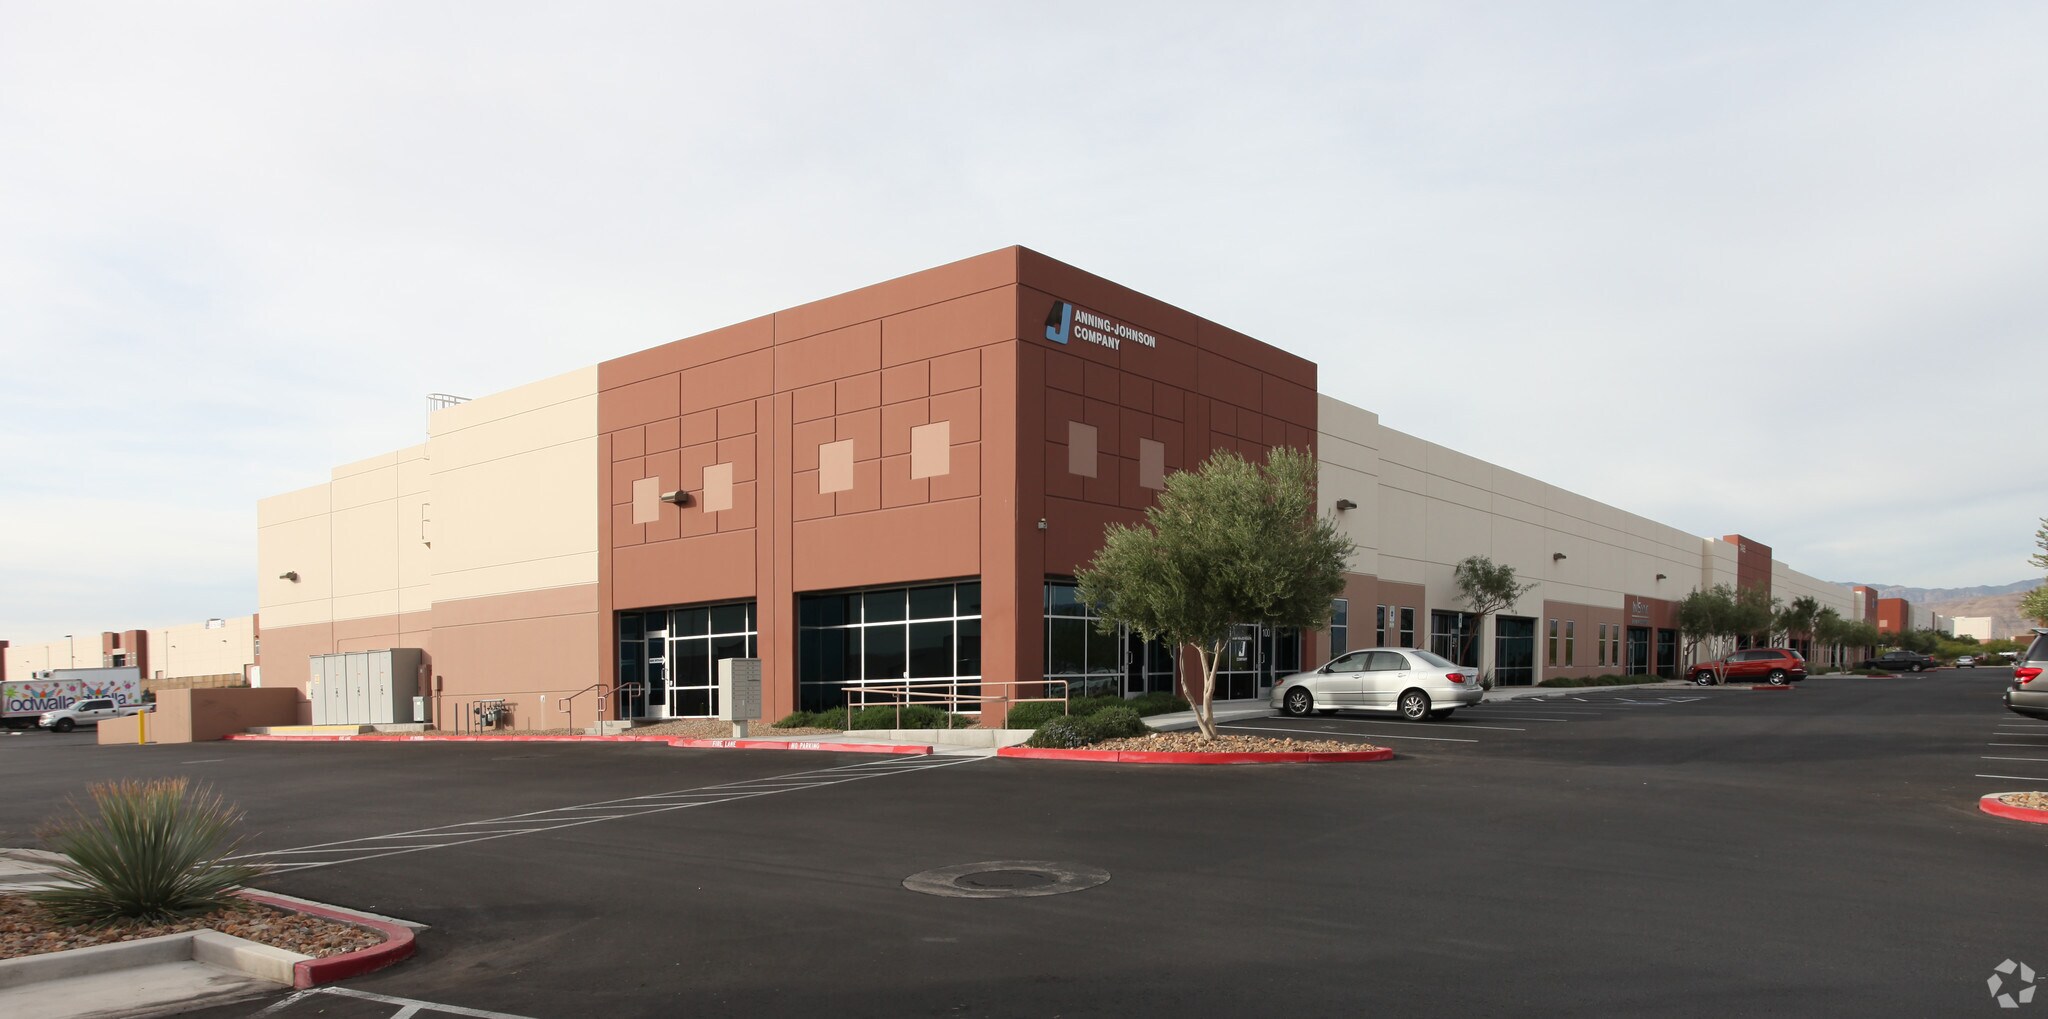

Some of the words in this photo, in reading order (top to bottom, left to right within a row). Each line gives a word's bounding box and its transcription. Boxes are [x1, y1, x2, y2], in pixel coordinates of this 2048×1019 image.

[1074, 309, 1156, 348] ANNING-JOHNSON
[1074, 325, 1120, 350] COMPANY
[712, 740, 723, 748] FIRE
[724, 740, 737, 748] LANE
[800, 742, 820, 750] PARKING
